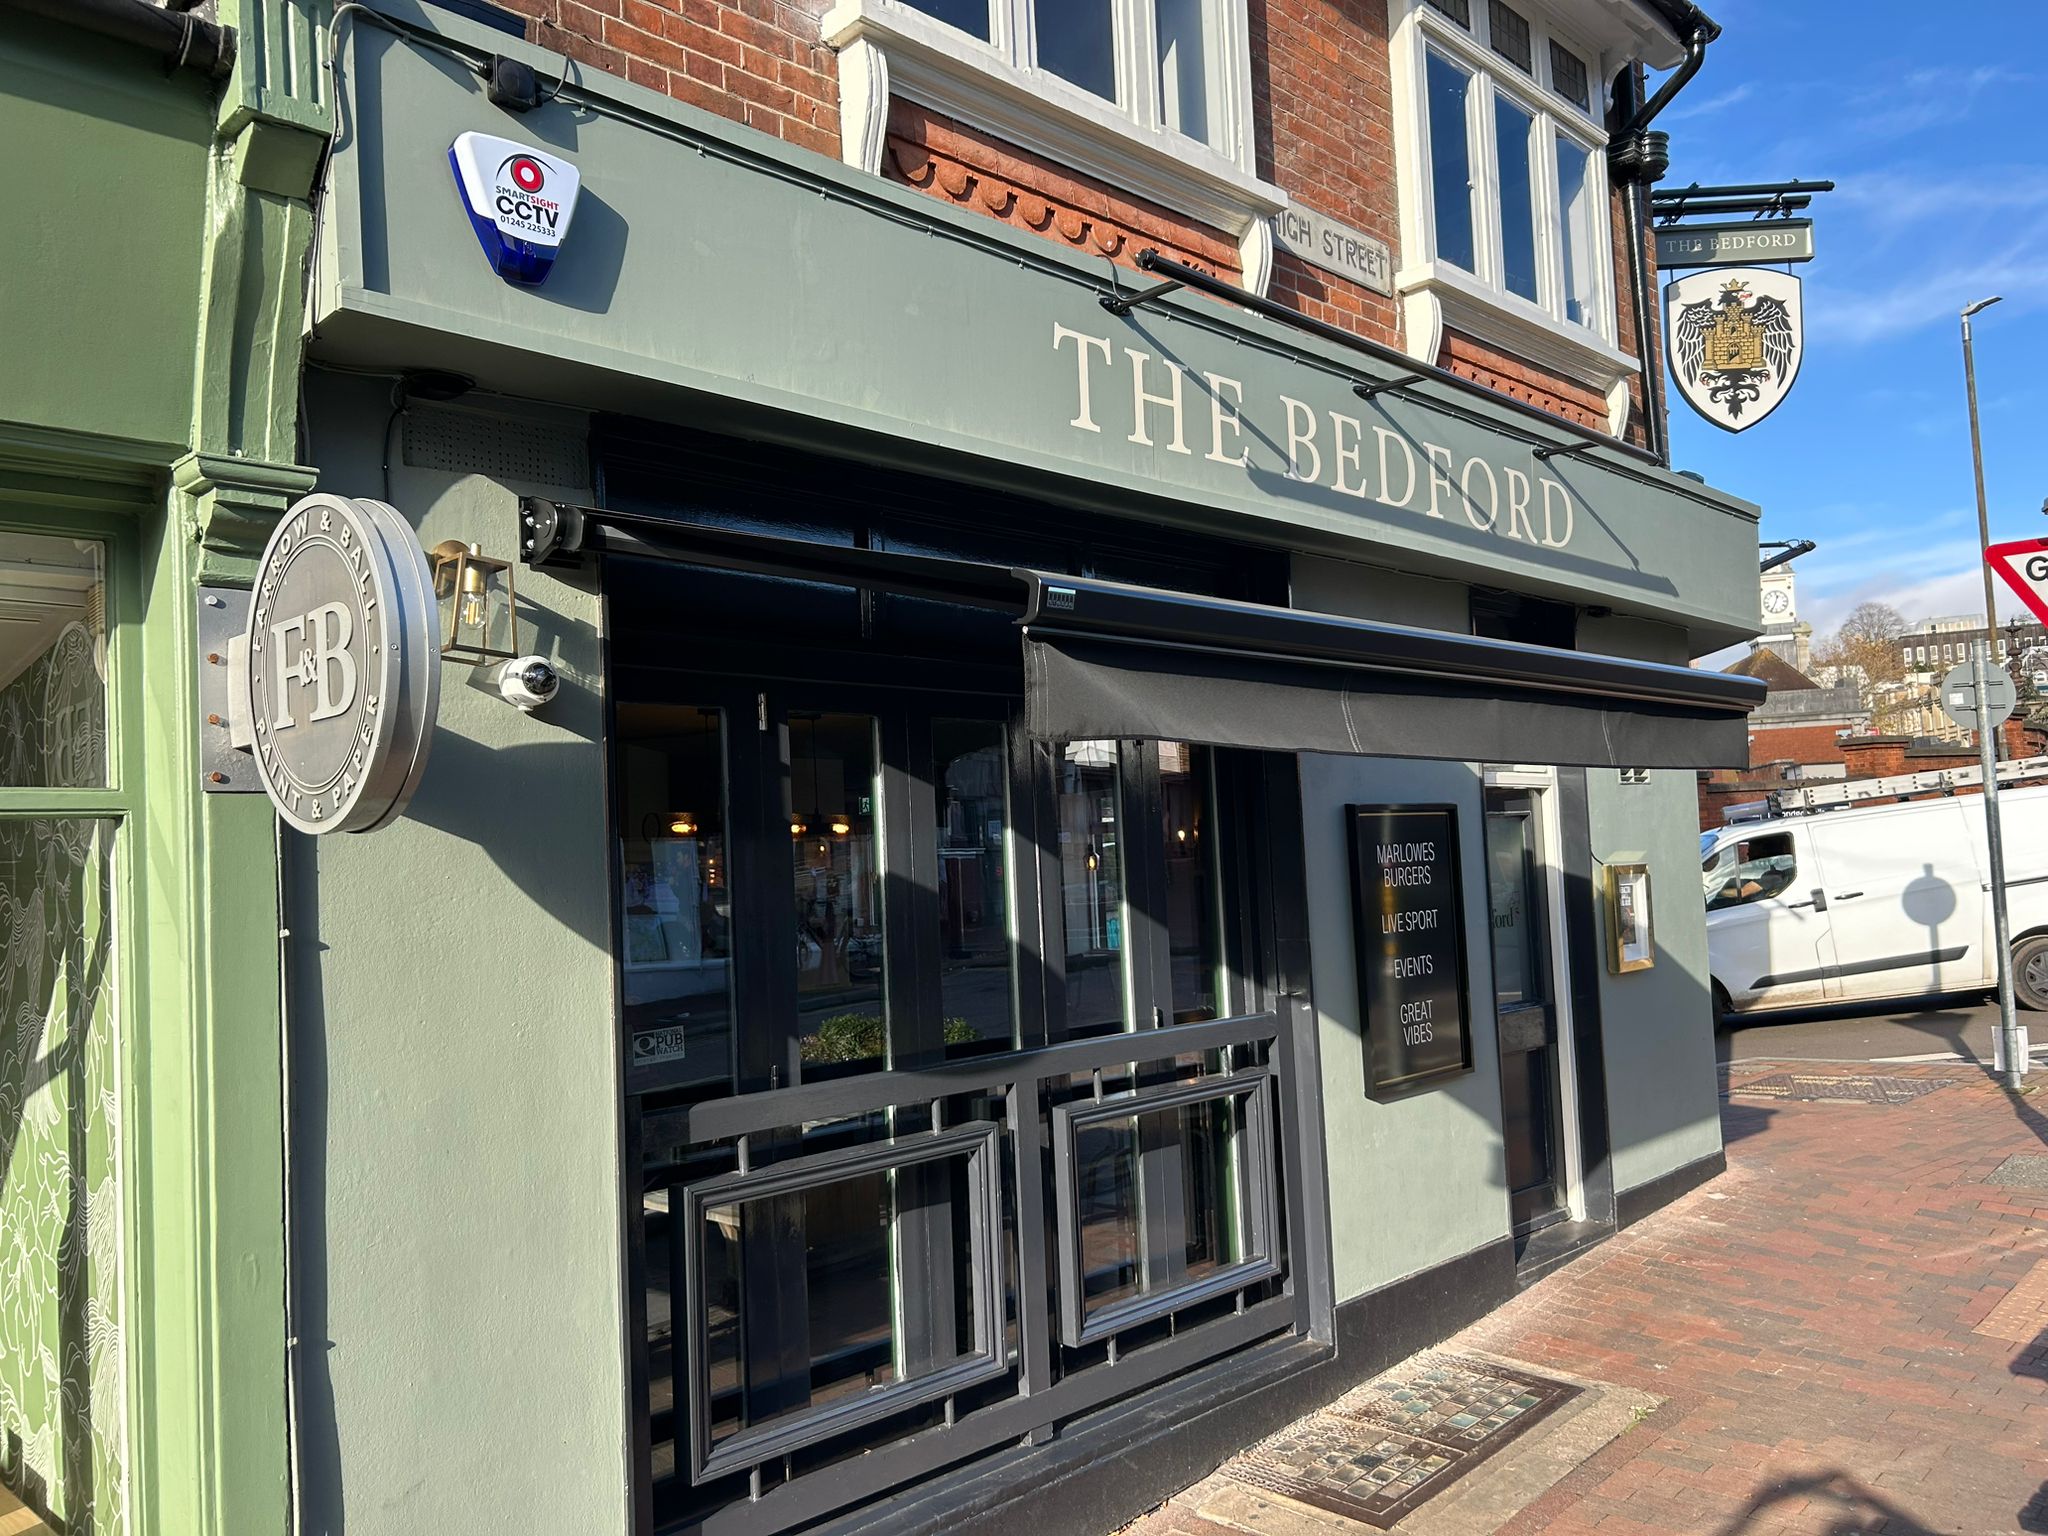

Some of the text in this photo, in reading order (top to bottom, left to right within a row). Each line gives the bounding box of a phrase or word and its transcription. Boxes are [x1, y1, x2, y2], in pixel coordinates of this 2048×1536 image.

[496, 195, 559, 229] CCTV
[500, 215, 556, 237] 01245 225333
[1322, 228, 1387, 280] STREET
[1665, 233, 1796, 252] THE BEDFORD
[1052, 321, 1575, 548] THE BEDFORD
[253, 510, 376, 652] FARROW & BALL
[270, 600, 358, 732] F&B
[255, 692, 379, 820] PAINT & PAPER
[1376, 842, 1436, 864] MARLOWES
[1383, 865, 1432, 888] BURGERS
[1381, 909, 1438, 934] LIVE SPORT
[1394, 954, 1434, 979] EVENTS
[1400, 999, 1433, 1024] GREAT
[656, 1033, 683, 1046] PUB
[1403, 1022, 1433, 1046] VIBES
[656, 1046, 684, 1056] WATCH
